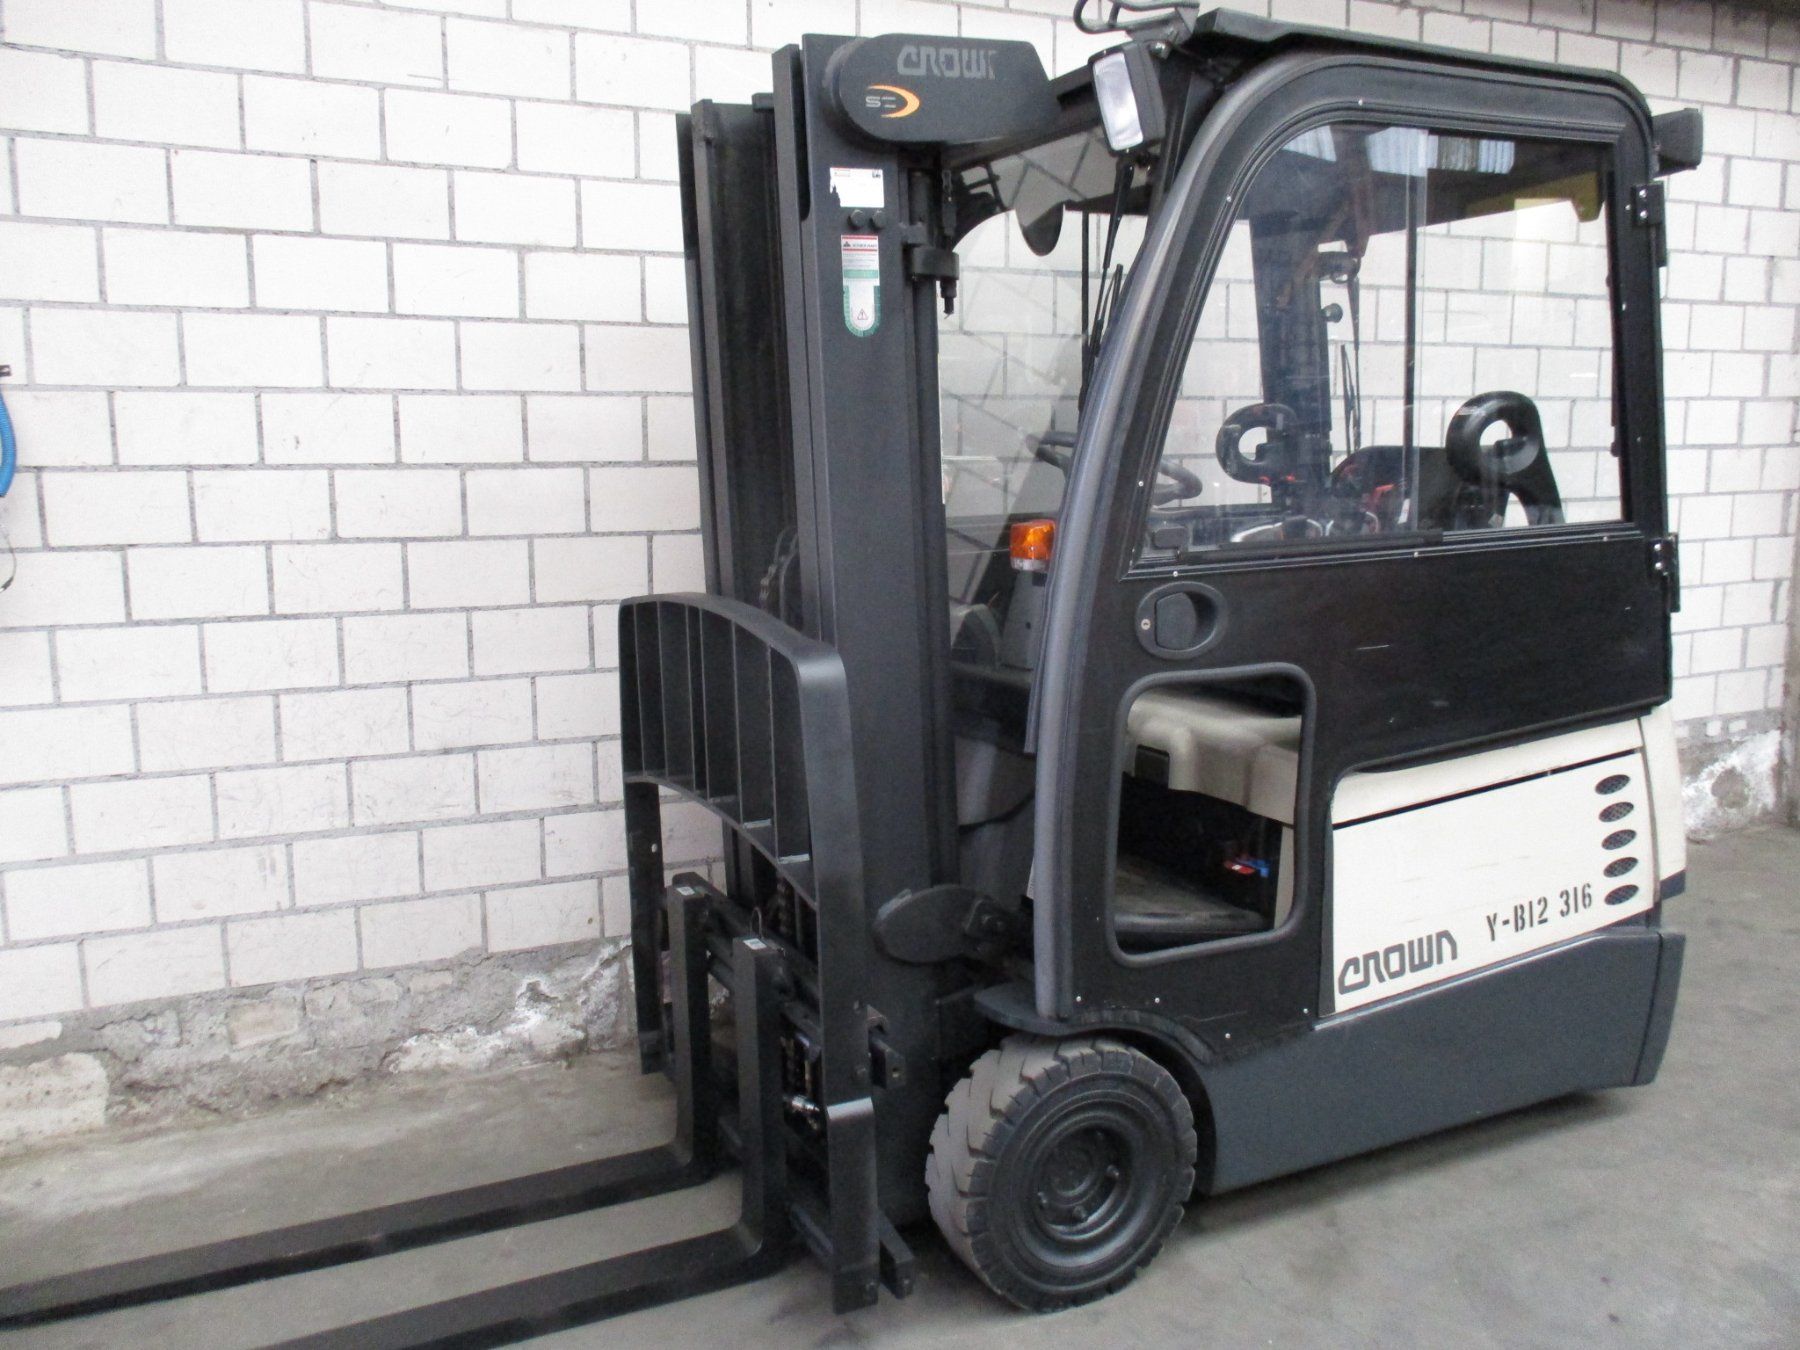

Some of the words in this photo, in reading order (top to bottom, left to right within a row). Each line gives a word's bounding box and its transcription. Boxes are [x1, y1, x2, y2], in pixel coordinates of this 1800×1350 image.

[1486, 896, 1549, 942] Y-B12
[1559, 883, 1593, 917] 316
[1338, 929, 1457, 994] CROWN
